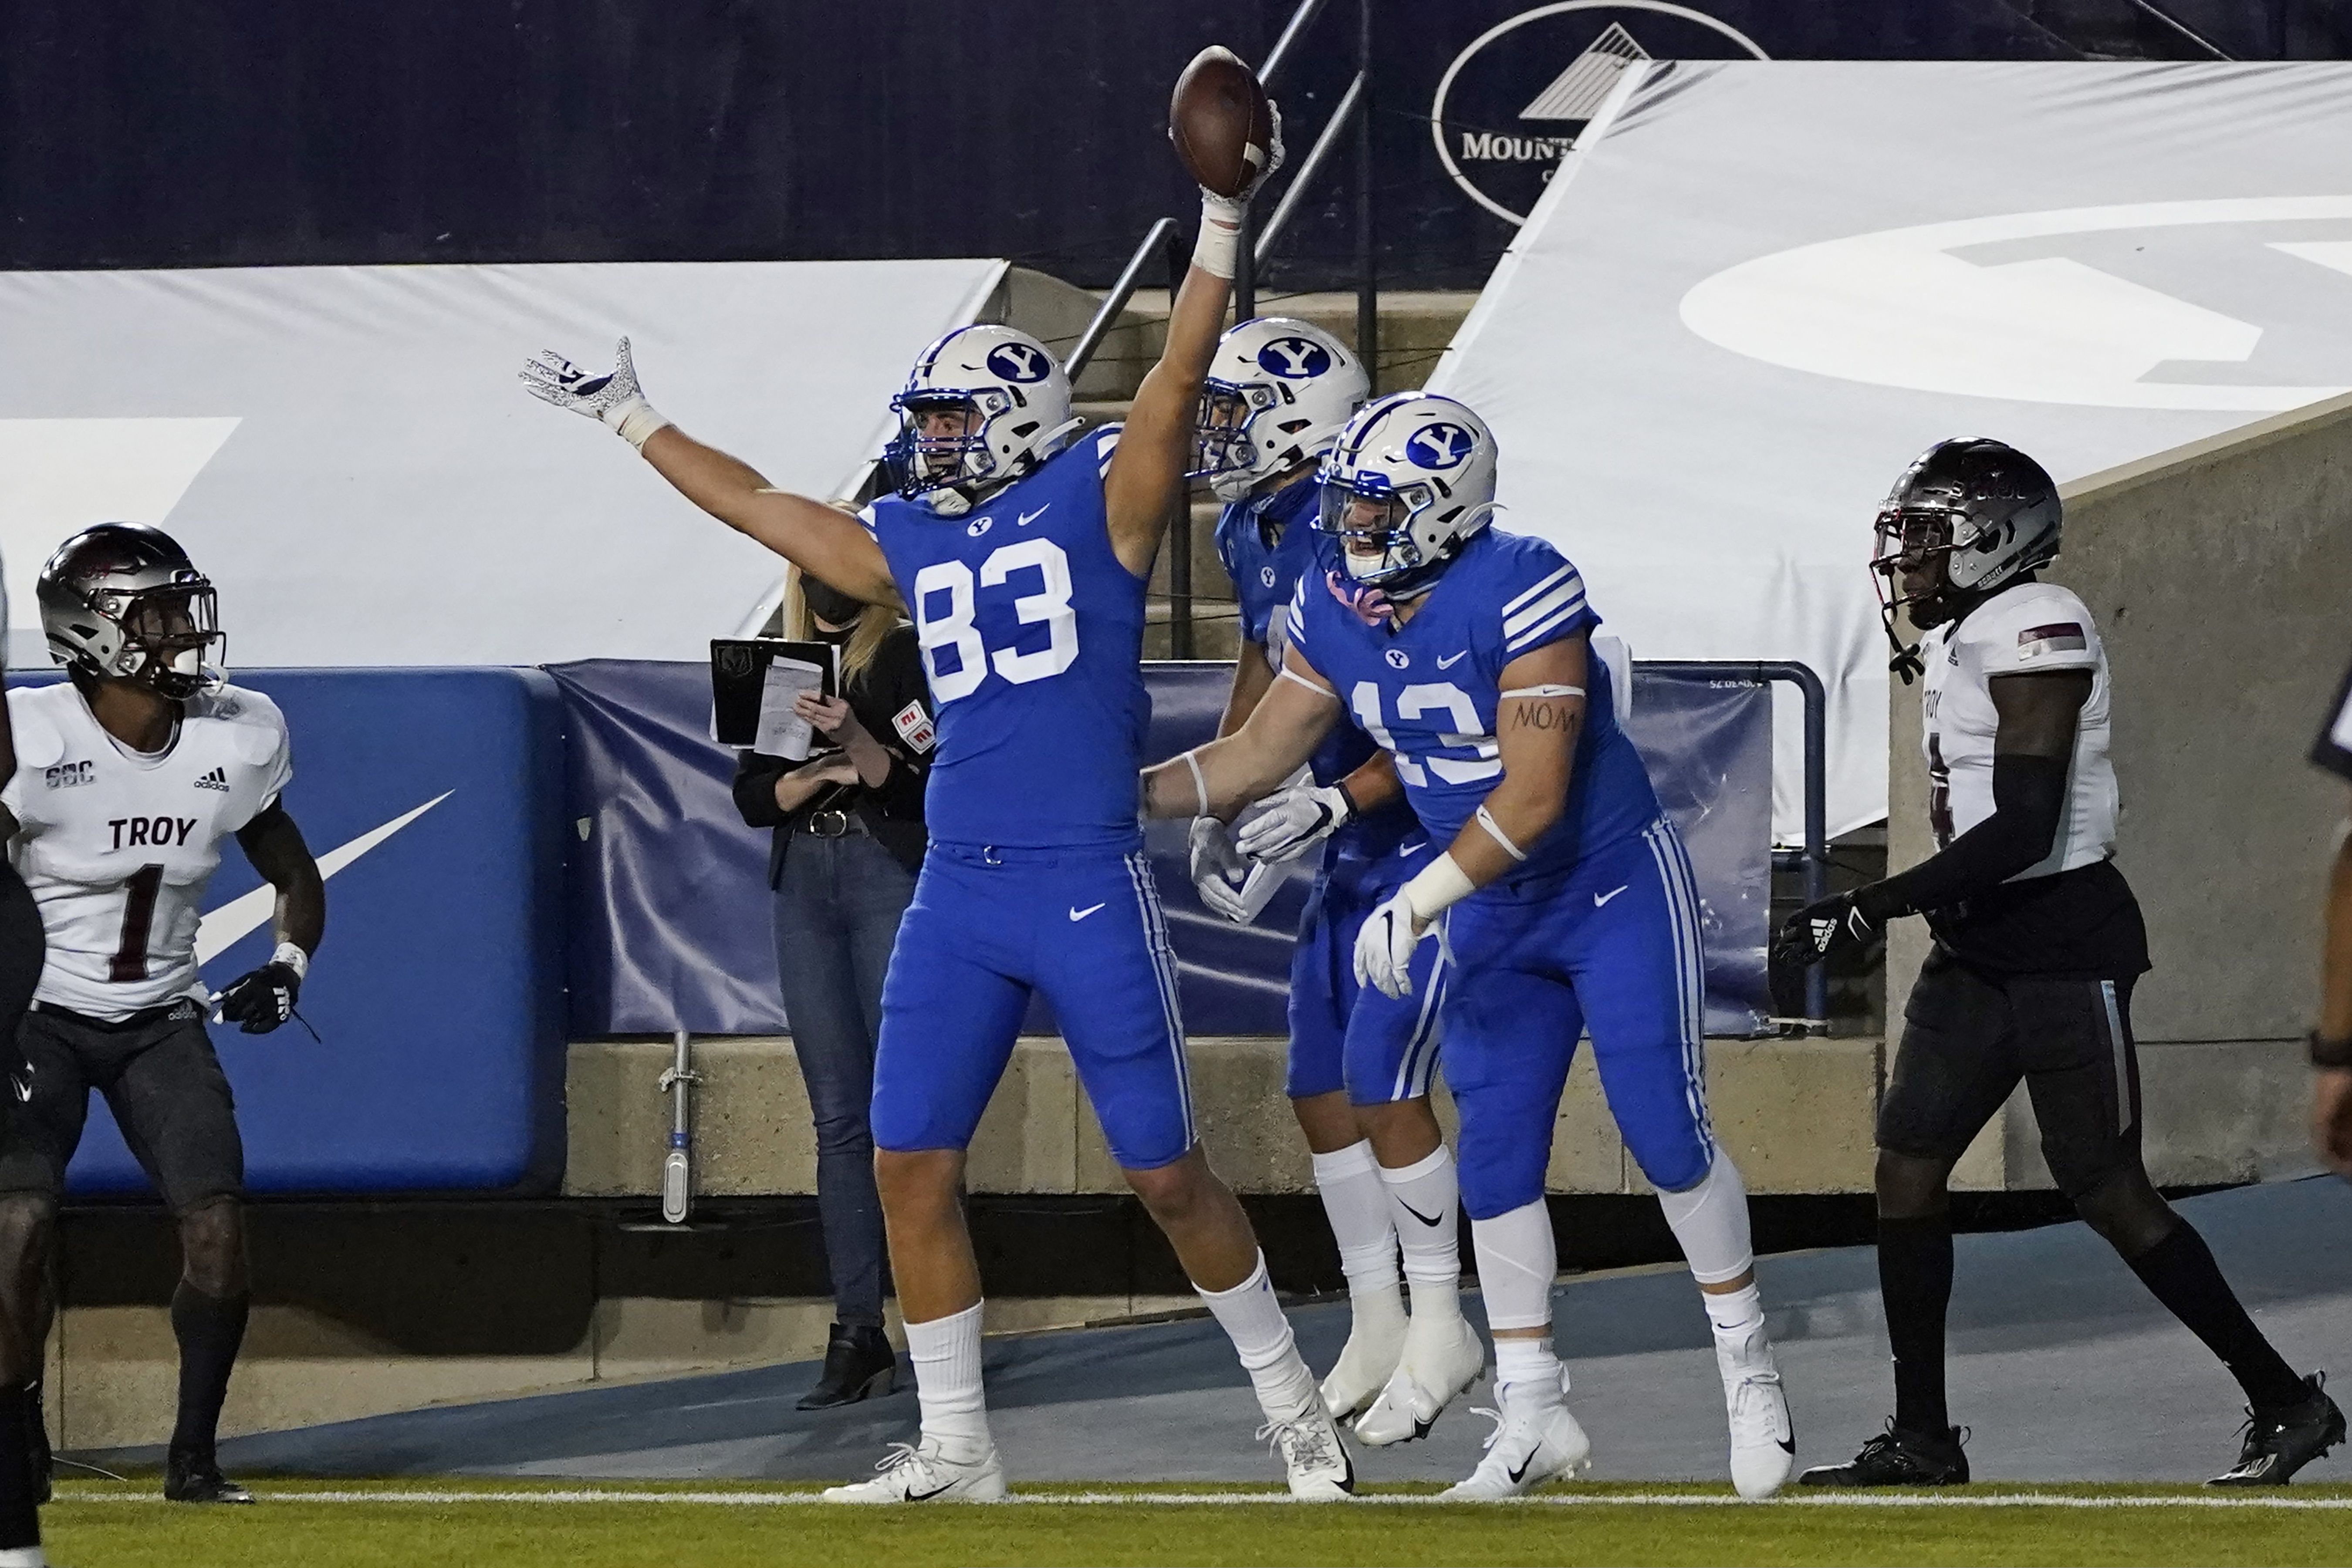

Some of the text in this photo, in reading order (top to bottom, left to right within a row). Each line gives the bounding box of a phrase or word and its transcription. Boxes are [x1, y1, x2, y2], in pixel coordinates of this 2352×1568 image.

[993, 345, 1037, 379] Y
[1267, 341, 1318, 375] Y
[1414, 425, 1460, 465] Y
[914, 537, 1080, 704] 83
[1510, 701, 1575, 732] MOM
[1351, 680, 1504, 788] 13
[193, 780, 230, 792] adidas
[108, 817, 197, 849] TROY
[109, 863, 165, 982] 1
[1817, 917, 1838, 952] adidas
